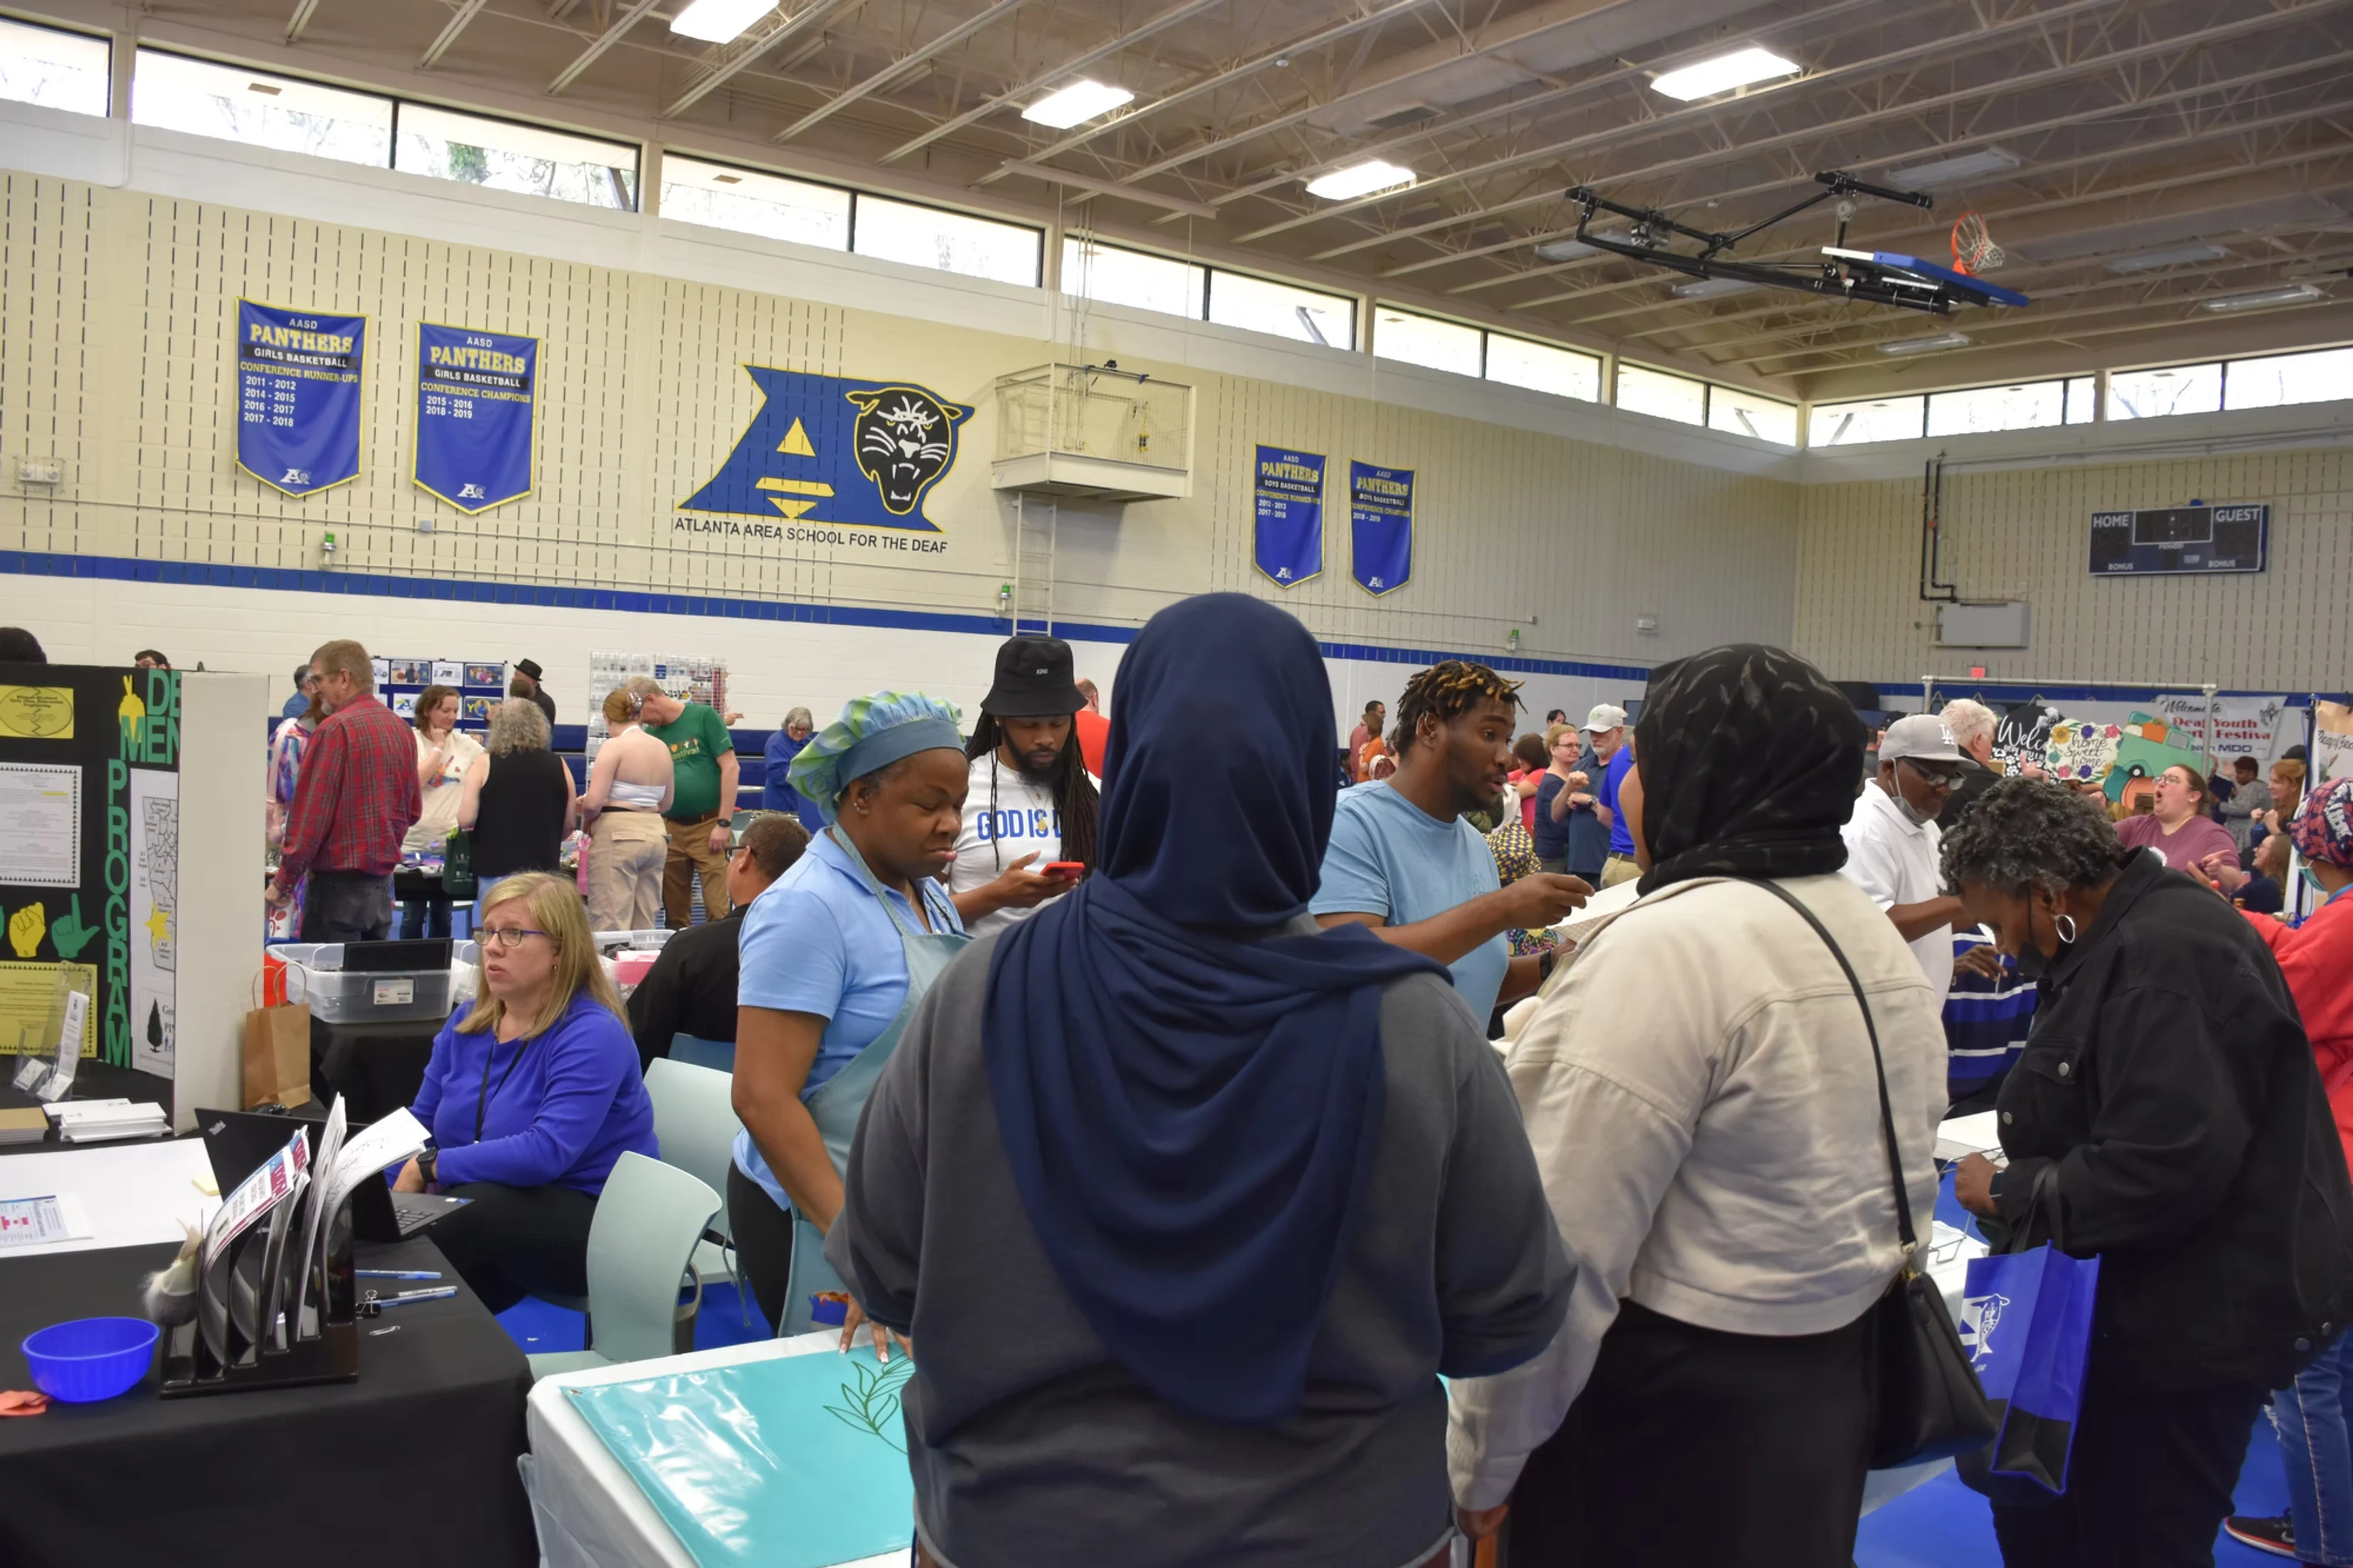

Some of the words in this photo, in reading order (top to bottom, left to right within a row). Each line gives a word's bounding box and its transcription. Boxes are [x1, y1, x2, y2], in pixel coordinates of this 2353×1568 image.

[289, 319, 318, 329] AASD
[250, 324, 354, 353] PANTHERS
[467, 336, 492, 348] AASD
[254, 348, 284, 360] GIRLS
[287, 353, 347, 368] BASKETBALL
[430, 346, 526, 374] PANTHERS
[240, 361, 302, 378] CONFERENCE
[304, 369, 358, 383] RUNNER-UPS
[435, 369, 461, 380] GIRLS
[464, 373, 521, 387] BASKETBALL
[246, 375, 265, 386] 2011
[275, 379, 296, 390] 2012
[245, 388, 265, 399] 2014
[274, 392, 295, 402] 2015
[421, 382, 479, 398] CONFERENCE
[481, 390, 531, 403] CHAMPIONS
[245, 400, 265, 411] 2016
[273, 404, 294, 415] 2017
[427, 395, 446, 405] 2015
[454, 399, 472, 409] 2016
[244, 412, 265, 423] 2017
[272, 416, 294, 427] 2018
[426, 405, 446, 415] 2018
[453, 409, 472, 419] 2019
[1283, 454, 1300, 463] AASD
[1261, 462, 1319, 483] PANTHERS
[1265, 480, 1279, 489] BOYS
[1280, 482, 1314, 493] BASKETBALL
[1356, 476, 1409, 496] PANTHERS
[2093, 515, 2129, 528] HOME
[2215, 508, 2260, 522] GUEST
[674, 517, 740, 535] ATLANTA
[744, 523, 783, 540] AREA
[787, 528, 845, 545] SCHOOL
[849, 533, 877, 548] FOR
[881, 536, 908, 550] THE
[912, 540, 947, 554] DEAF
[2214, 718, 2258, 729] Youth
[1938, 724, 1955, 745] LA
[2071, 731, 2108, 748] home
[2071, 754, 2107, 767] home
[977, 809, 1024, 841] GOD
[1027, 809, 1049, 838] IS
[105, 758, 129, 1070] PROGRAM
